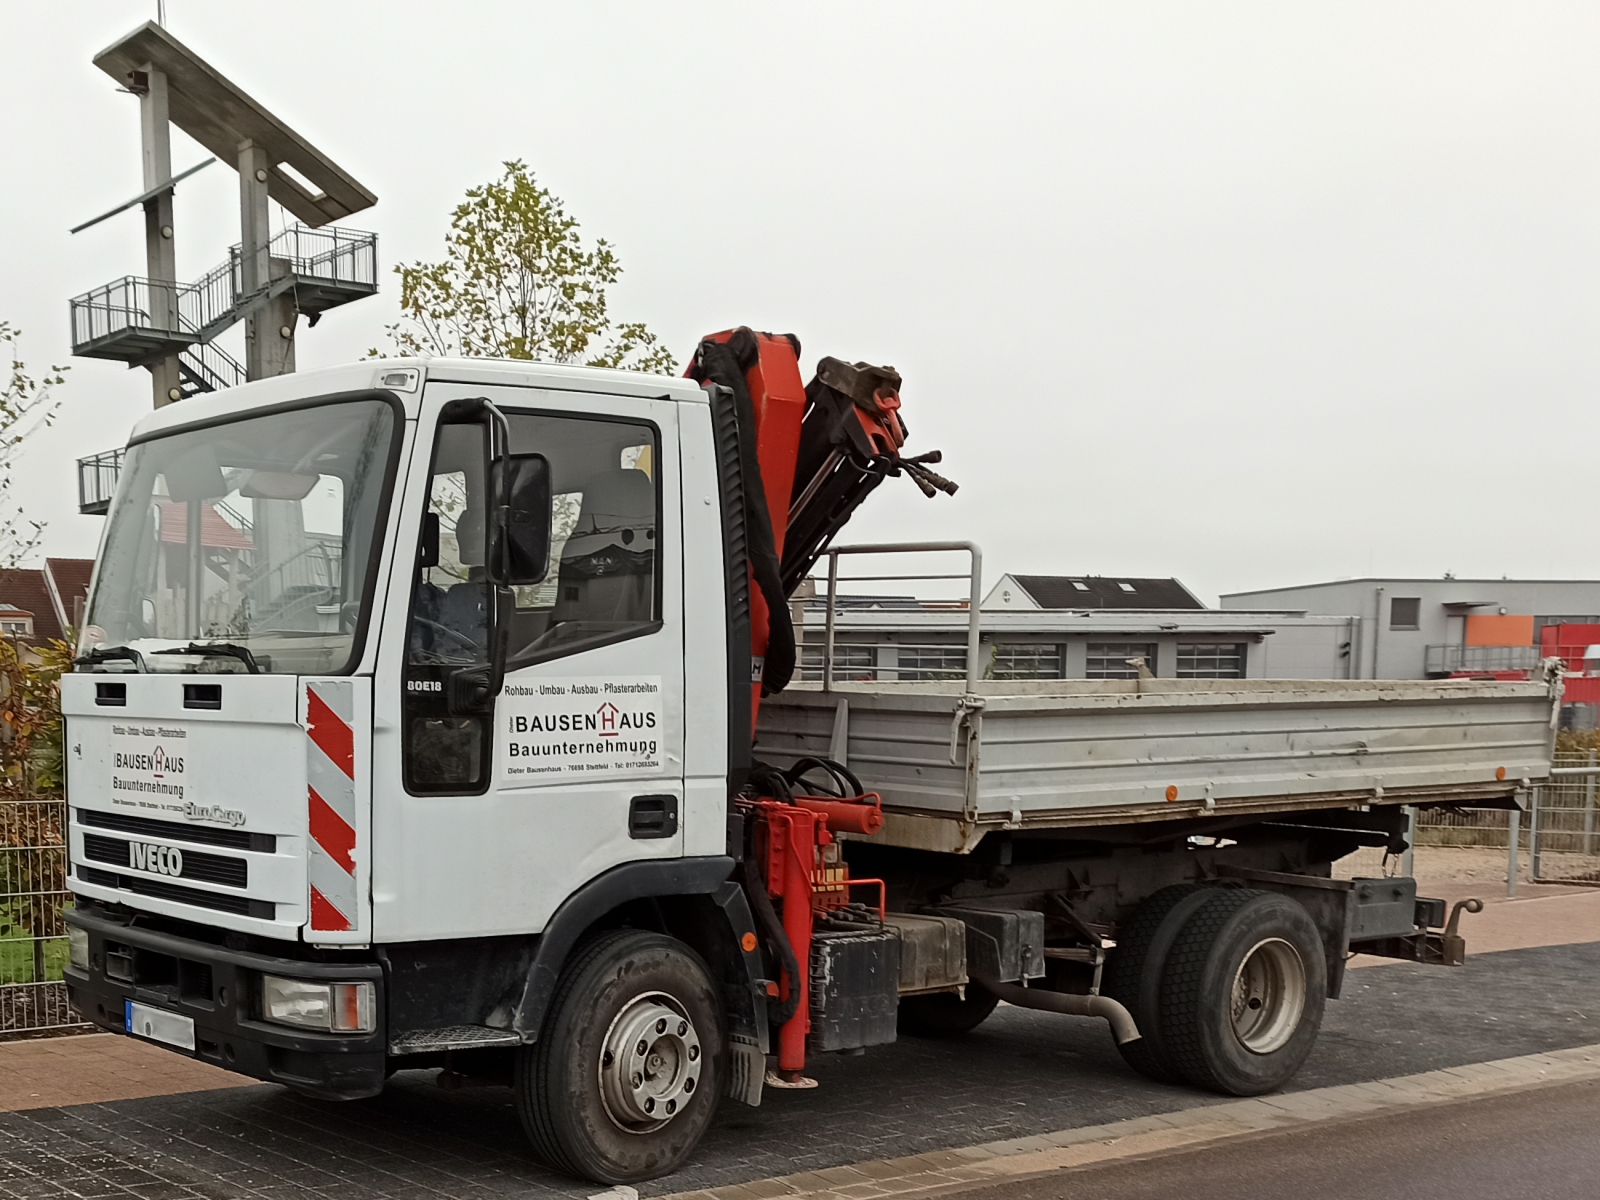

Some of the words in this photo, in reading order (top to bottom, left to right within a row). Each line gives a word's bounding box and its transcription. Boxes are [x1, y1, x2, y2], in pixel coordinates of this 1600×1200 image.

[504, 685, 534, 696] Rohbau
[539, 684, 565, 695] Umbau
[571, 684, 599, 694] Ausbau
[604, 682, 658, 693] Pflasterarbeiten
[516, 711, 656, 733] BAUSENHAUS
[509, 739, 657, 757] Bauunternehmung
[116, 753, 184, 774] BAUSENHAUS
[113, 776, 184, 799] Bauunternehmung
[129, 841, 183, 876] IVECO
